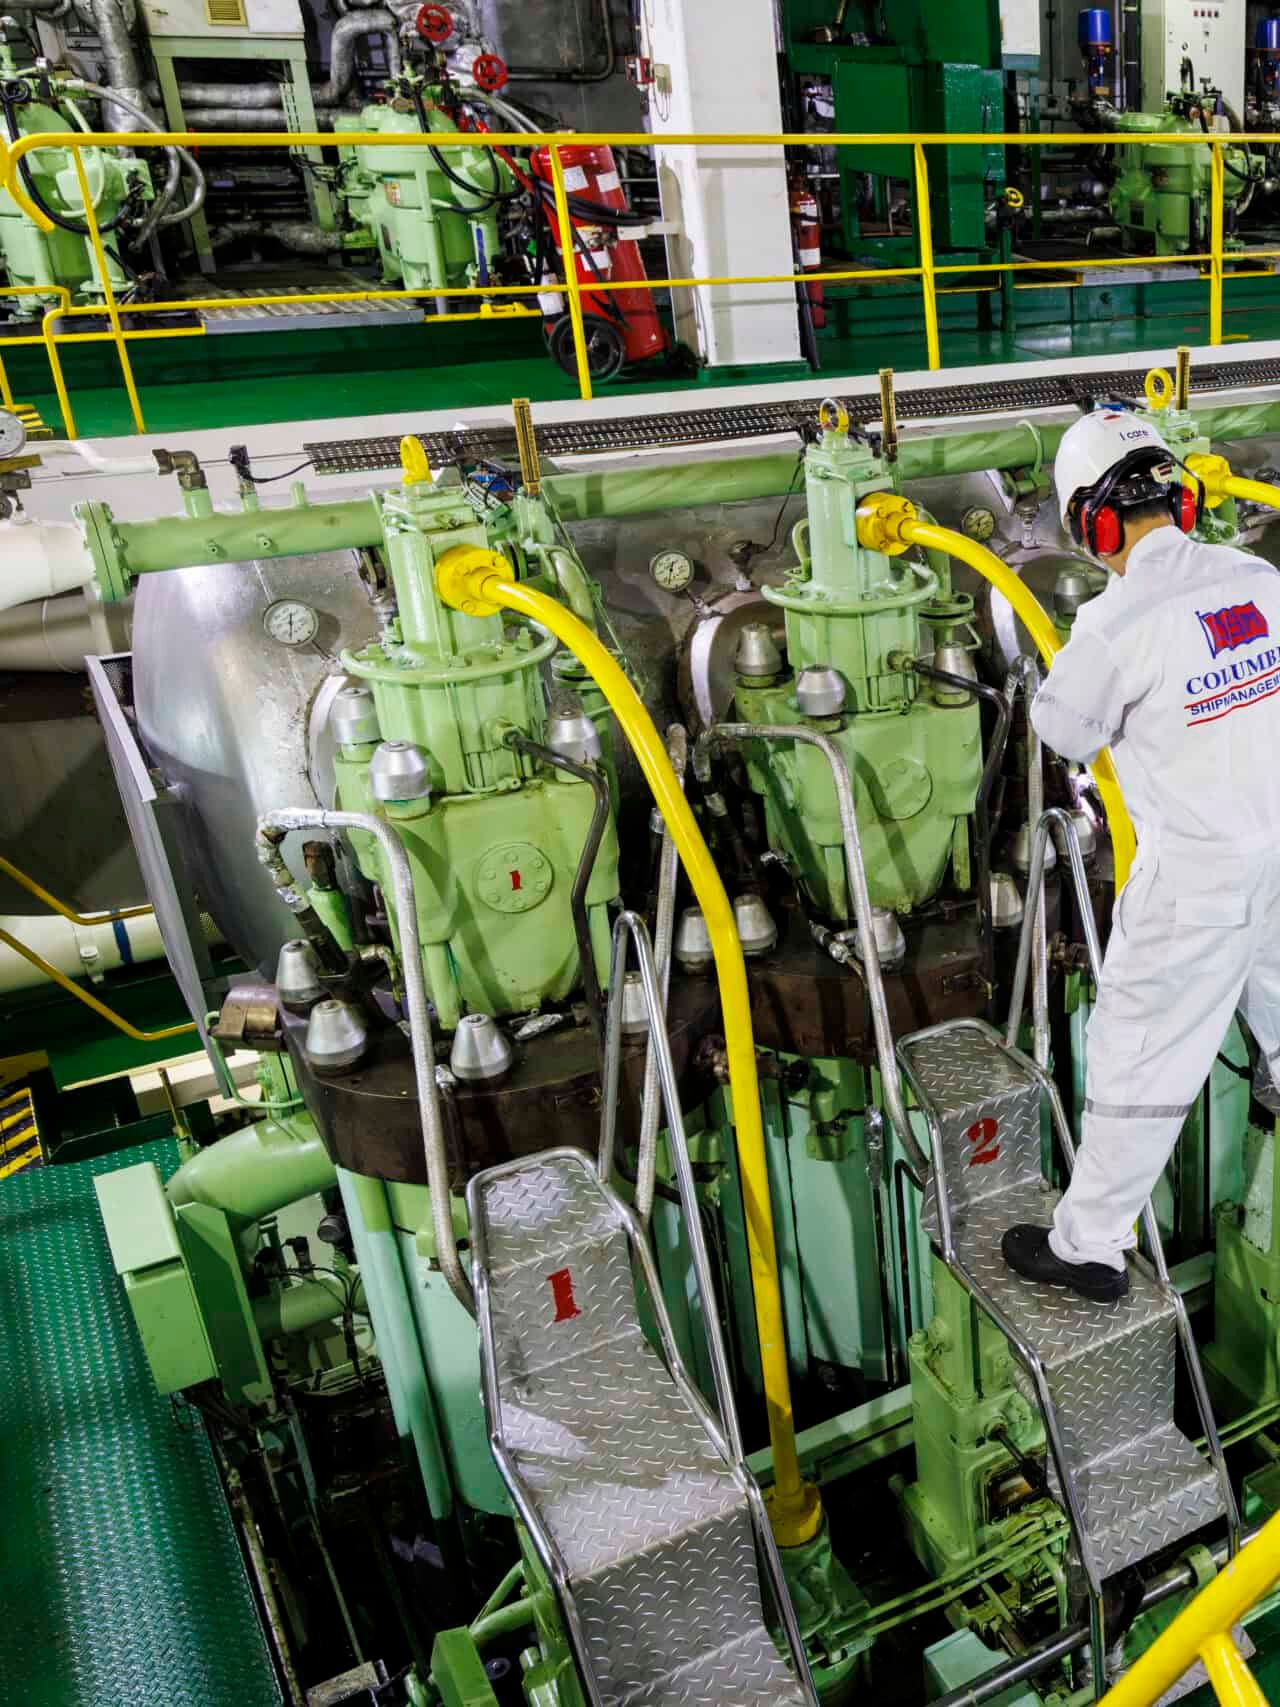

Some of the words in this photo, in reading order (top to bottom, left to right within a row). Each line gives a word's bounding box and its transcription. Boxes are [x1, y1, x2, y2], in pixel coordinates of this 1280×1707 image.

[509, 870, 523, 891] 1
[966, 1116, 1001, 1169] 2
[546, 1267, 583, 1323] 1
